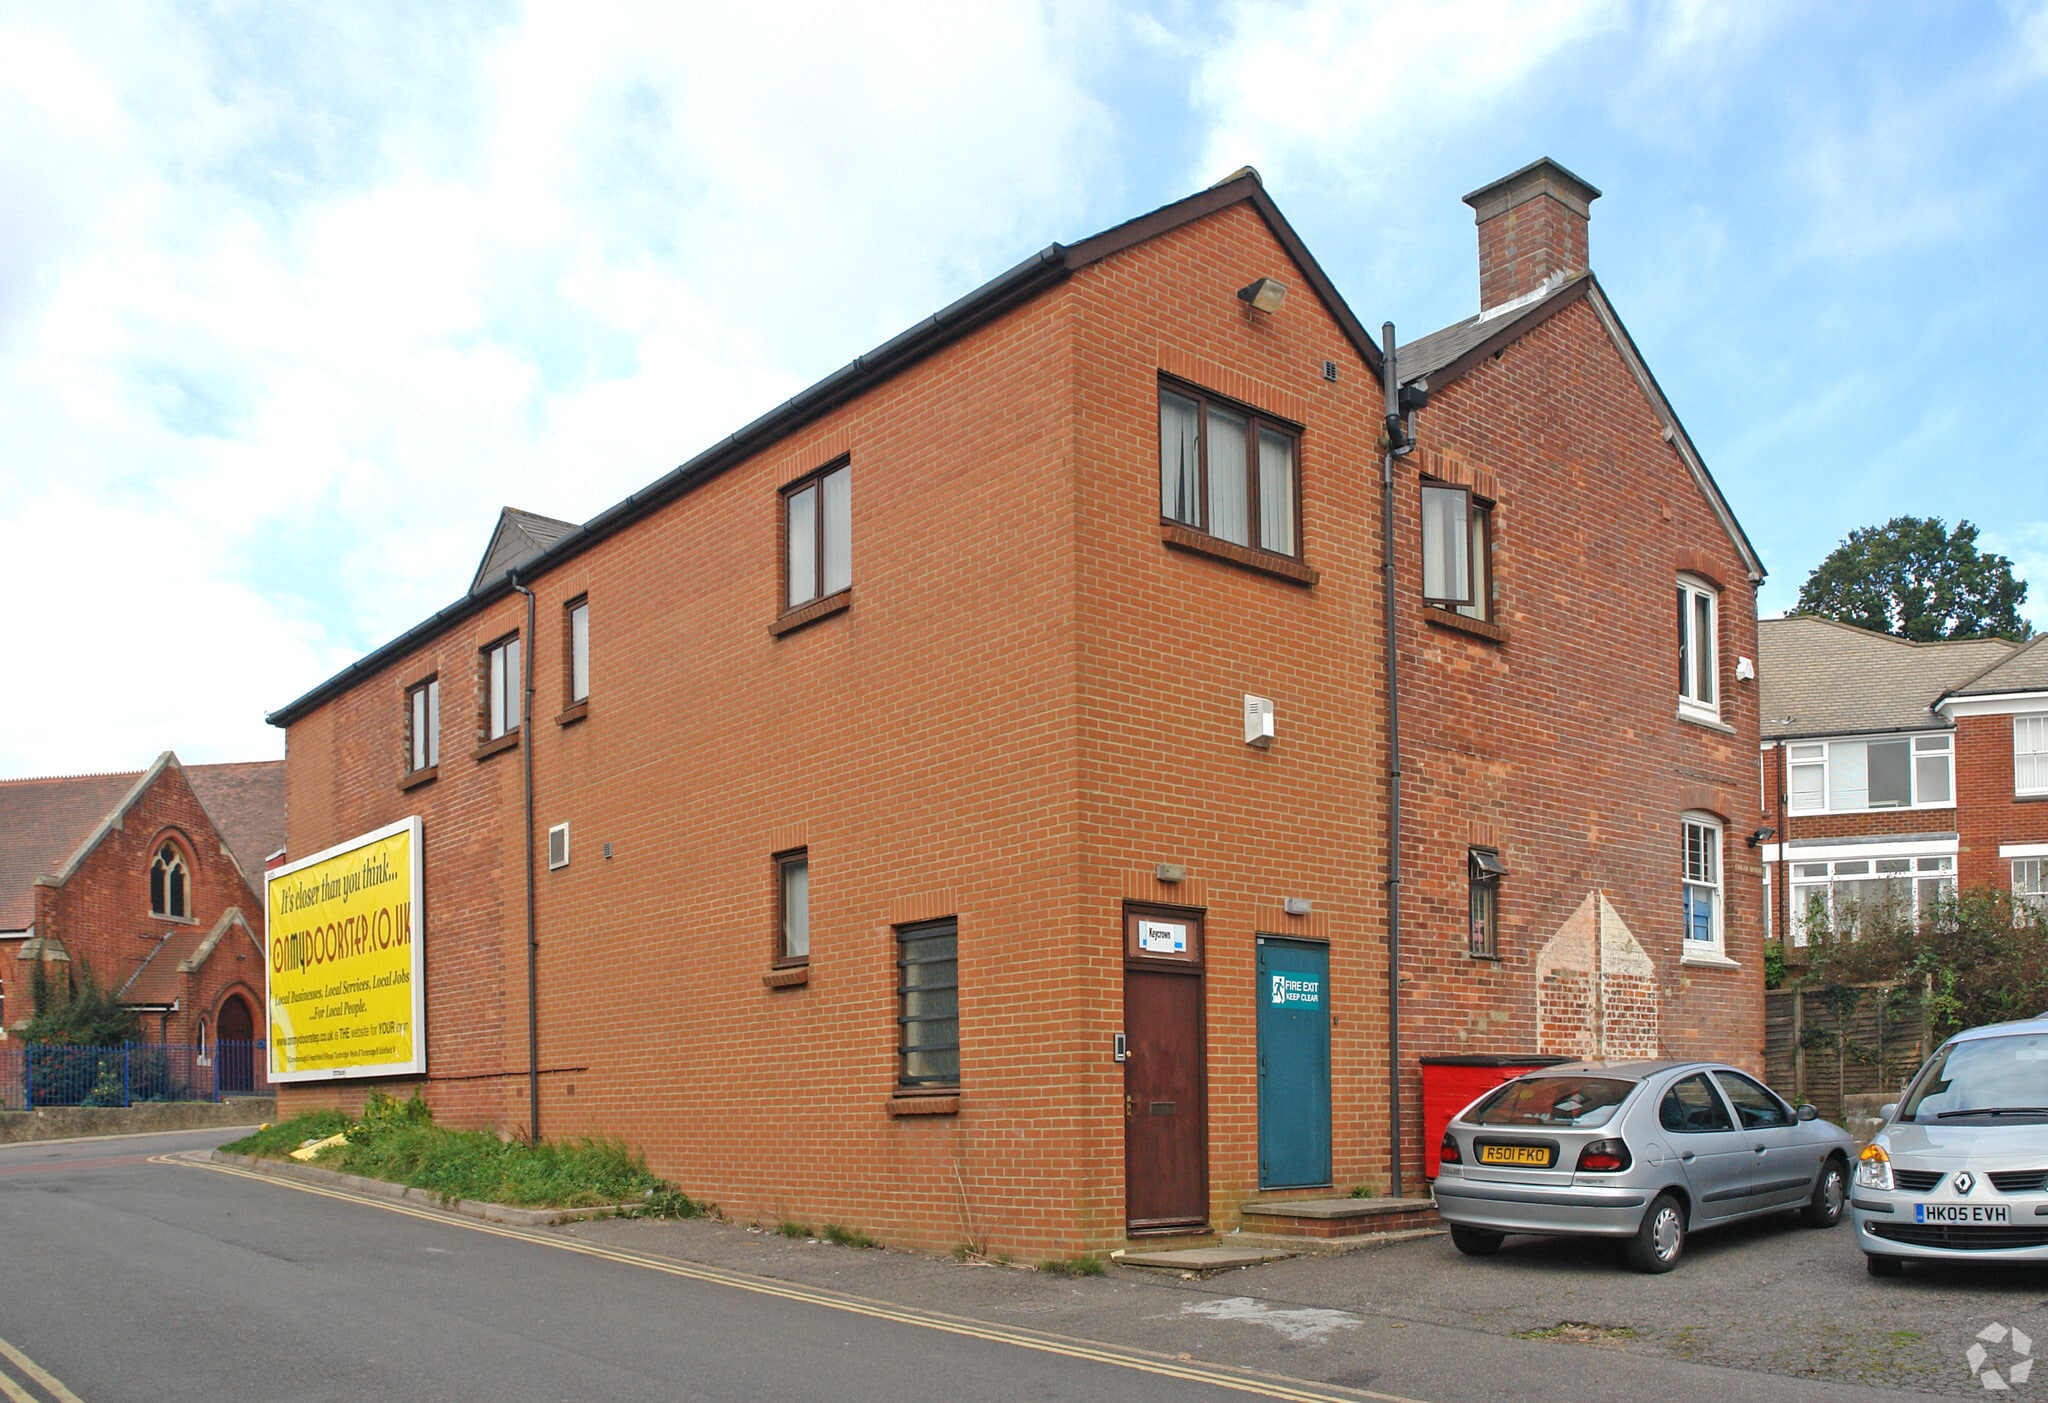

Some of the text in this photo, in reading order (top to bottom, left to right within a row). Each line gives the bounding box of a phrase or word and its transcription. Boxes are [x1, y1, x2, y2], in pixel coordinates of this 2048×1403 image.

[281, 852, 398, 914] It's closer than you think...
[1149, 927, 1171, 941] Keycrown
[275, 968, 410, 1006] Local Businesses, Local Services, Local Jobs
[1285, 980, 1319, 992] FIRE EXIT
[1286, 992, 1319, 1002] KEEP CLEAR
[325, 1001, 343, 1018] Local
[344, 998, 367, 1017] People.
[339, 1027, 350, 1039] THE
[378, 1021, 394, 1034] YOUR
[1487, 1147, 1515, 1160] R501
[1926, 1206, 2006, 1221] HK05 EVH
